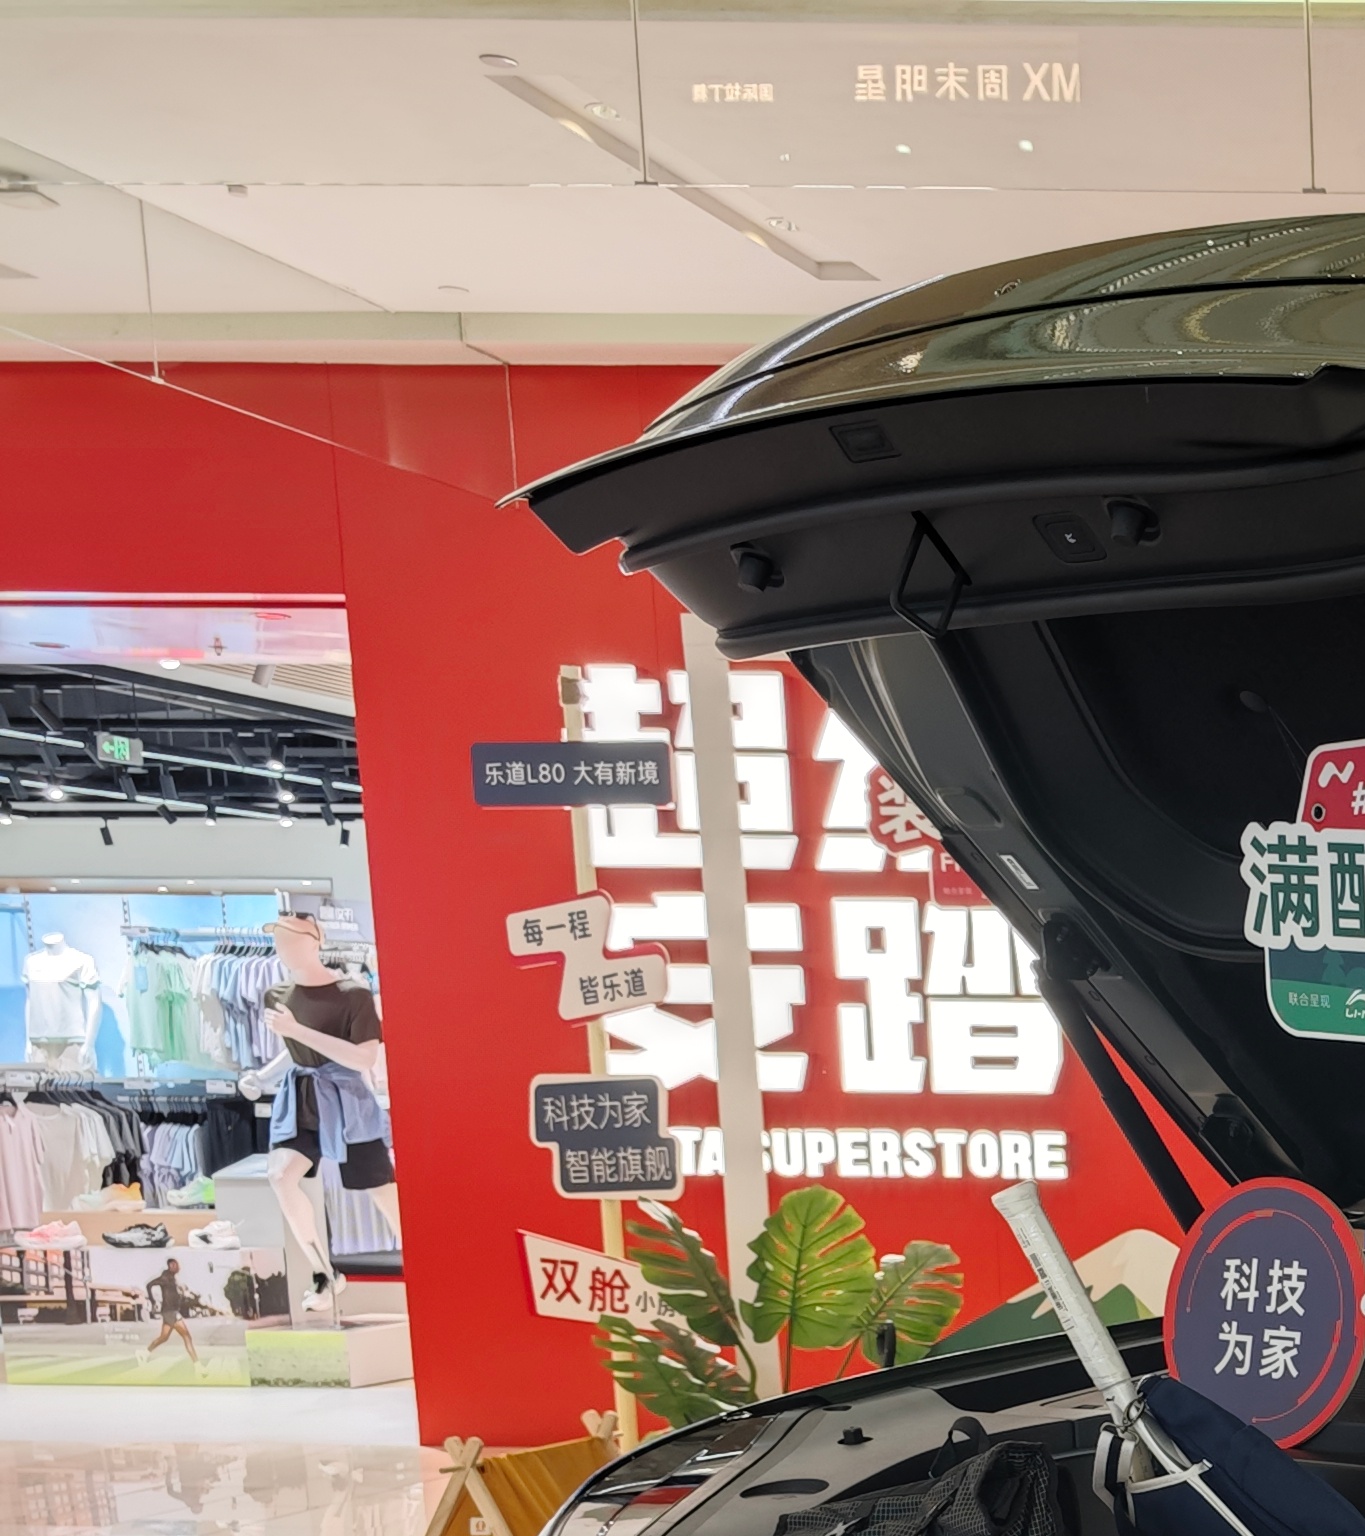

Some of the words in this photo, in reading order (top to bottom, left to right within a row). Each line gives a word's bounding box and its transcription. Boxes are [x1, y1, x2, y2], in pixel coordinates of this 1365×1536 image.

[484, 761, 566, 786] 乐道L80
[572, 760, 660, 786] 大有新境
[522, 910, 593, 947] 每一程
[578, 967, 648, 1006] 皆乐道
[1288, 991, 1331, 1008] 联合呈现
[542, 1091, 652, 1132] 科技为家
[565, 1145, 673, 1184] 智能旗舰
[539, 1257, 632, 1315] 双舱
[1220, 1257, 1308, 1317] 科技
[1213, 1320, 1302, 1380] 为家
